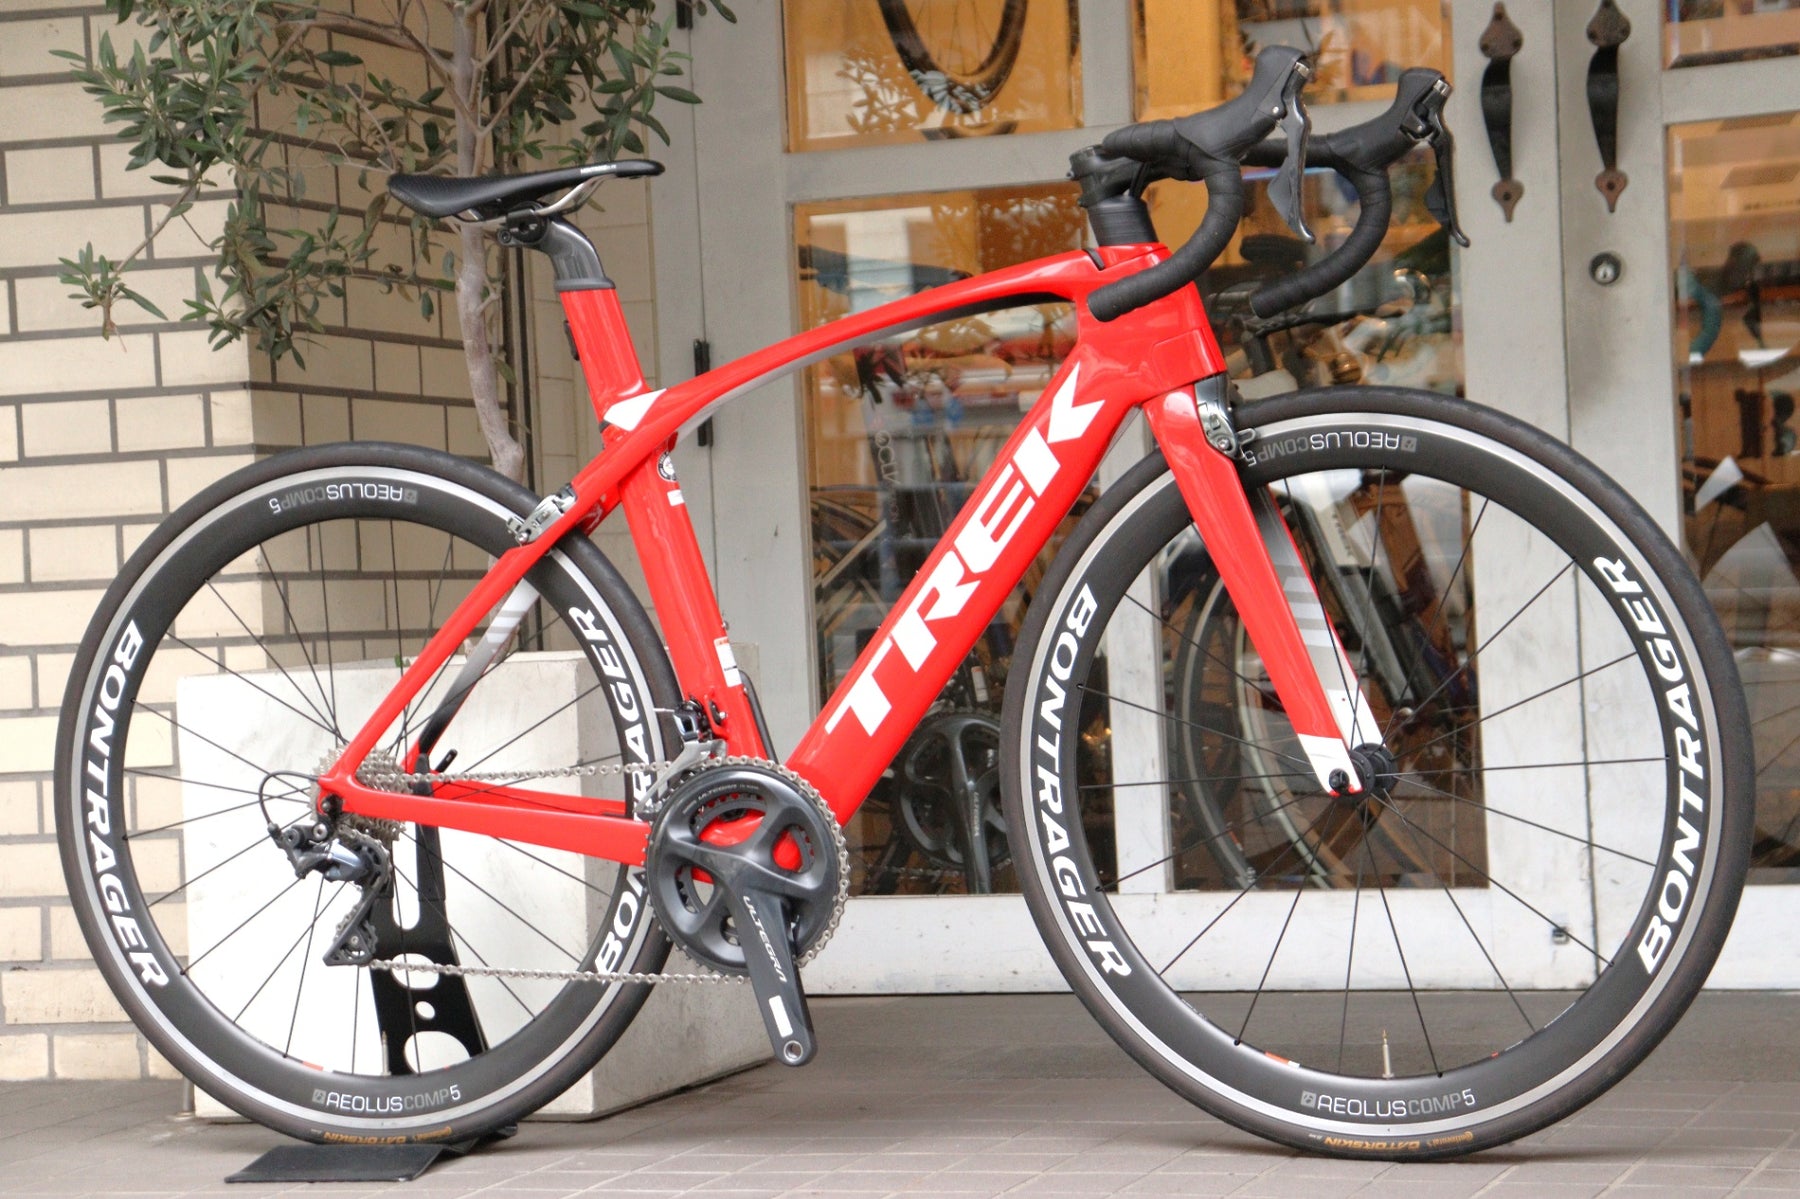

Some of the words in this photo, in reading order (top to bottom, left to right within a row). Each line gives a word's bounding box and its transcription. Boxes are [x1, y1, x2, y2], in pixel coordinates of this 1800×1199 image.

[824, 361, 1105, 736] TREK
[87, 619, 169, 987] BONTRAGER
[743, 895, 787, 983] ULTEGRA
[1037, 583, 1132, 977] BONTRAGER
[1593, 556, 1704, 974] BONTRAGER
[1323, 1135, 1421, 1150] GATORSKIN
